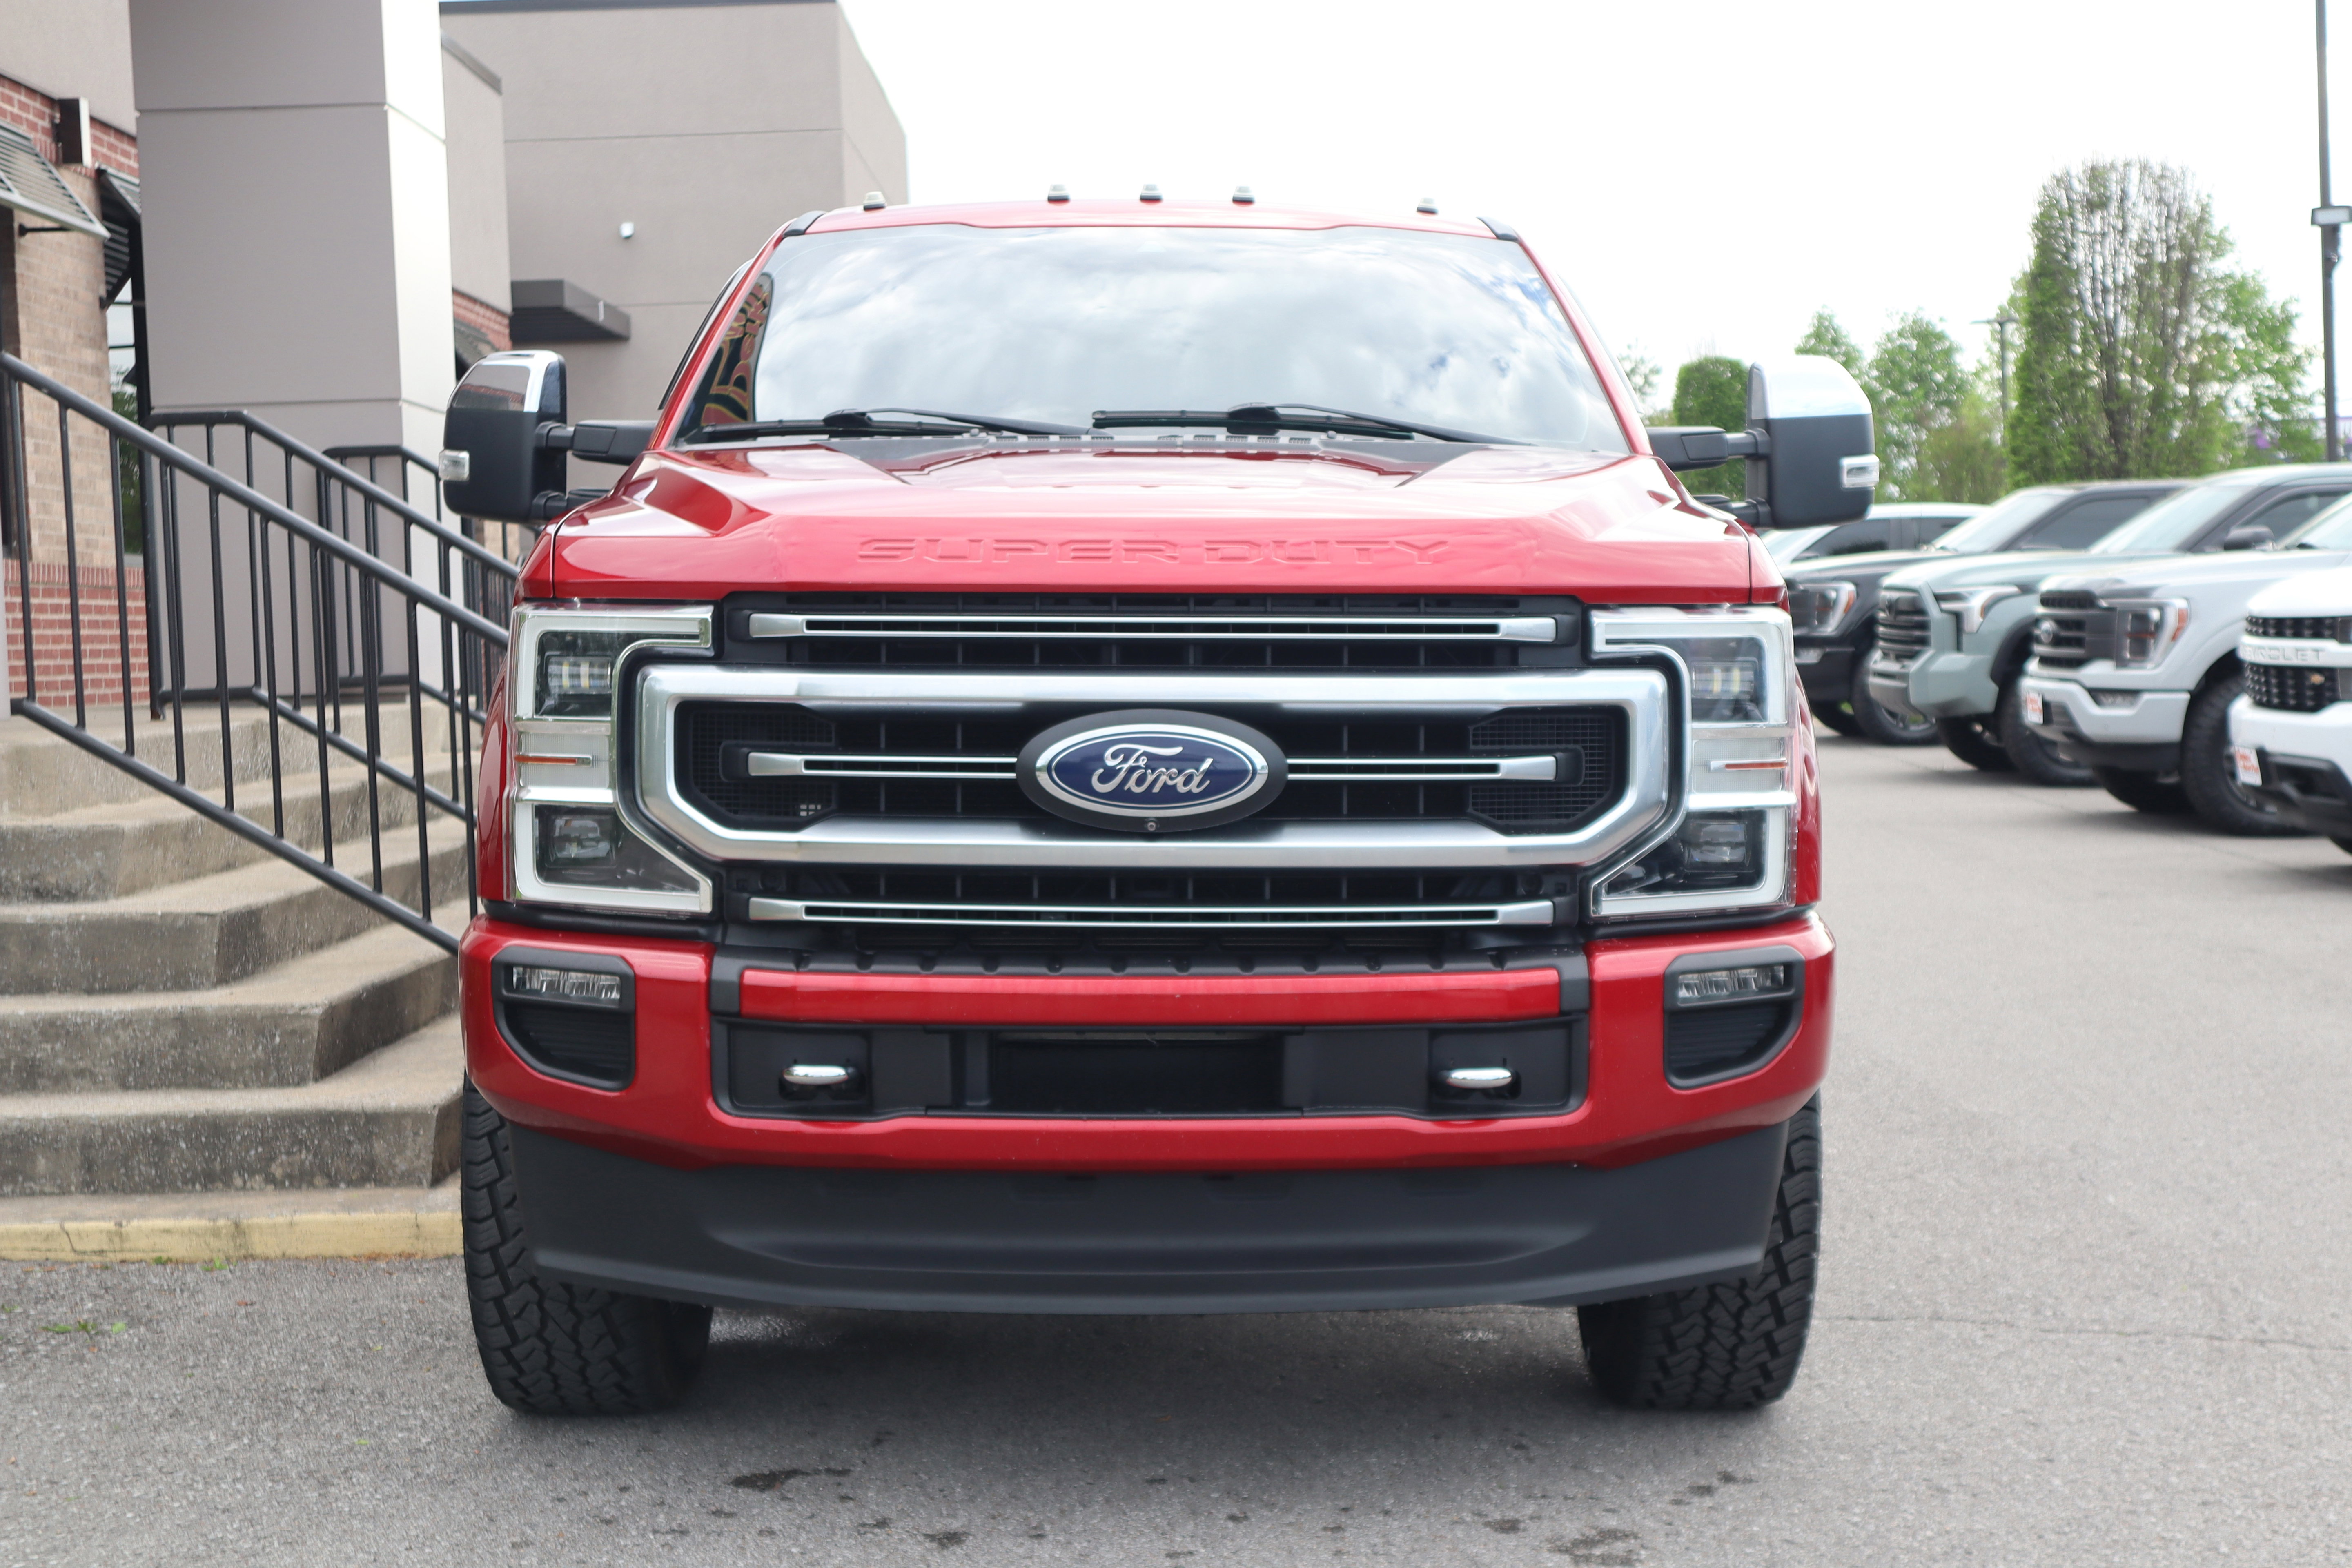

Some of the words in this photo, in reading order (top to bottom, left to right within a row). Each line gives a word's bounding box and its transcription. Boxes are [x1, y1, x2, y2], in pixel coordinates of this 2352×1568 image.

[857, 538, 1180, 563] SUPER
[1204, 540, 1448, 564] DUTY
[1091, 743, 1213, 793] Ford
